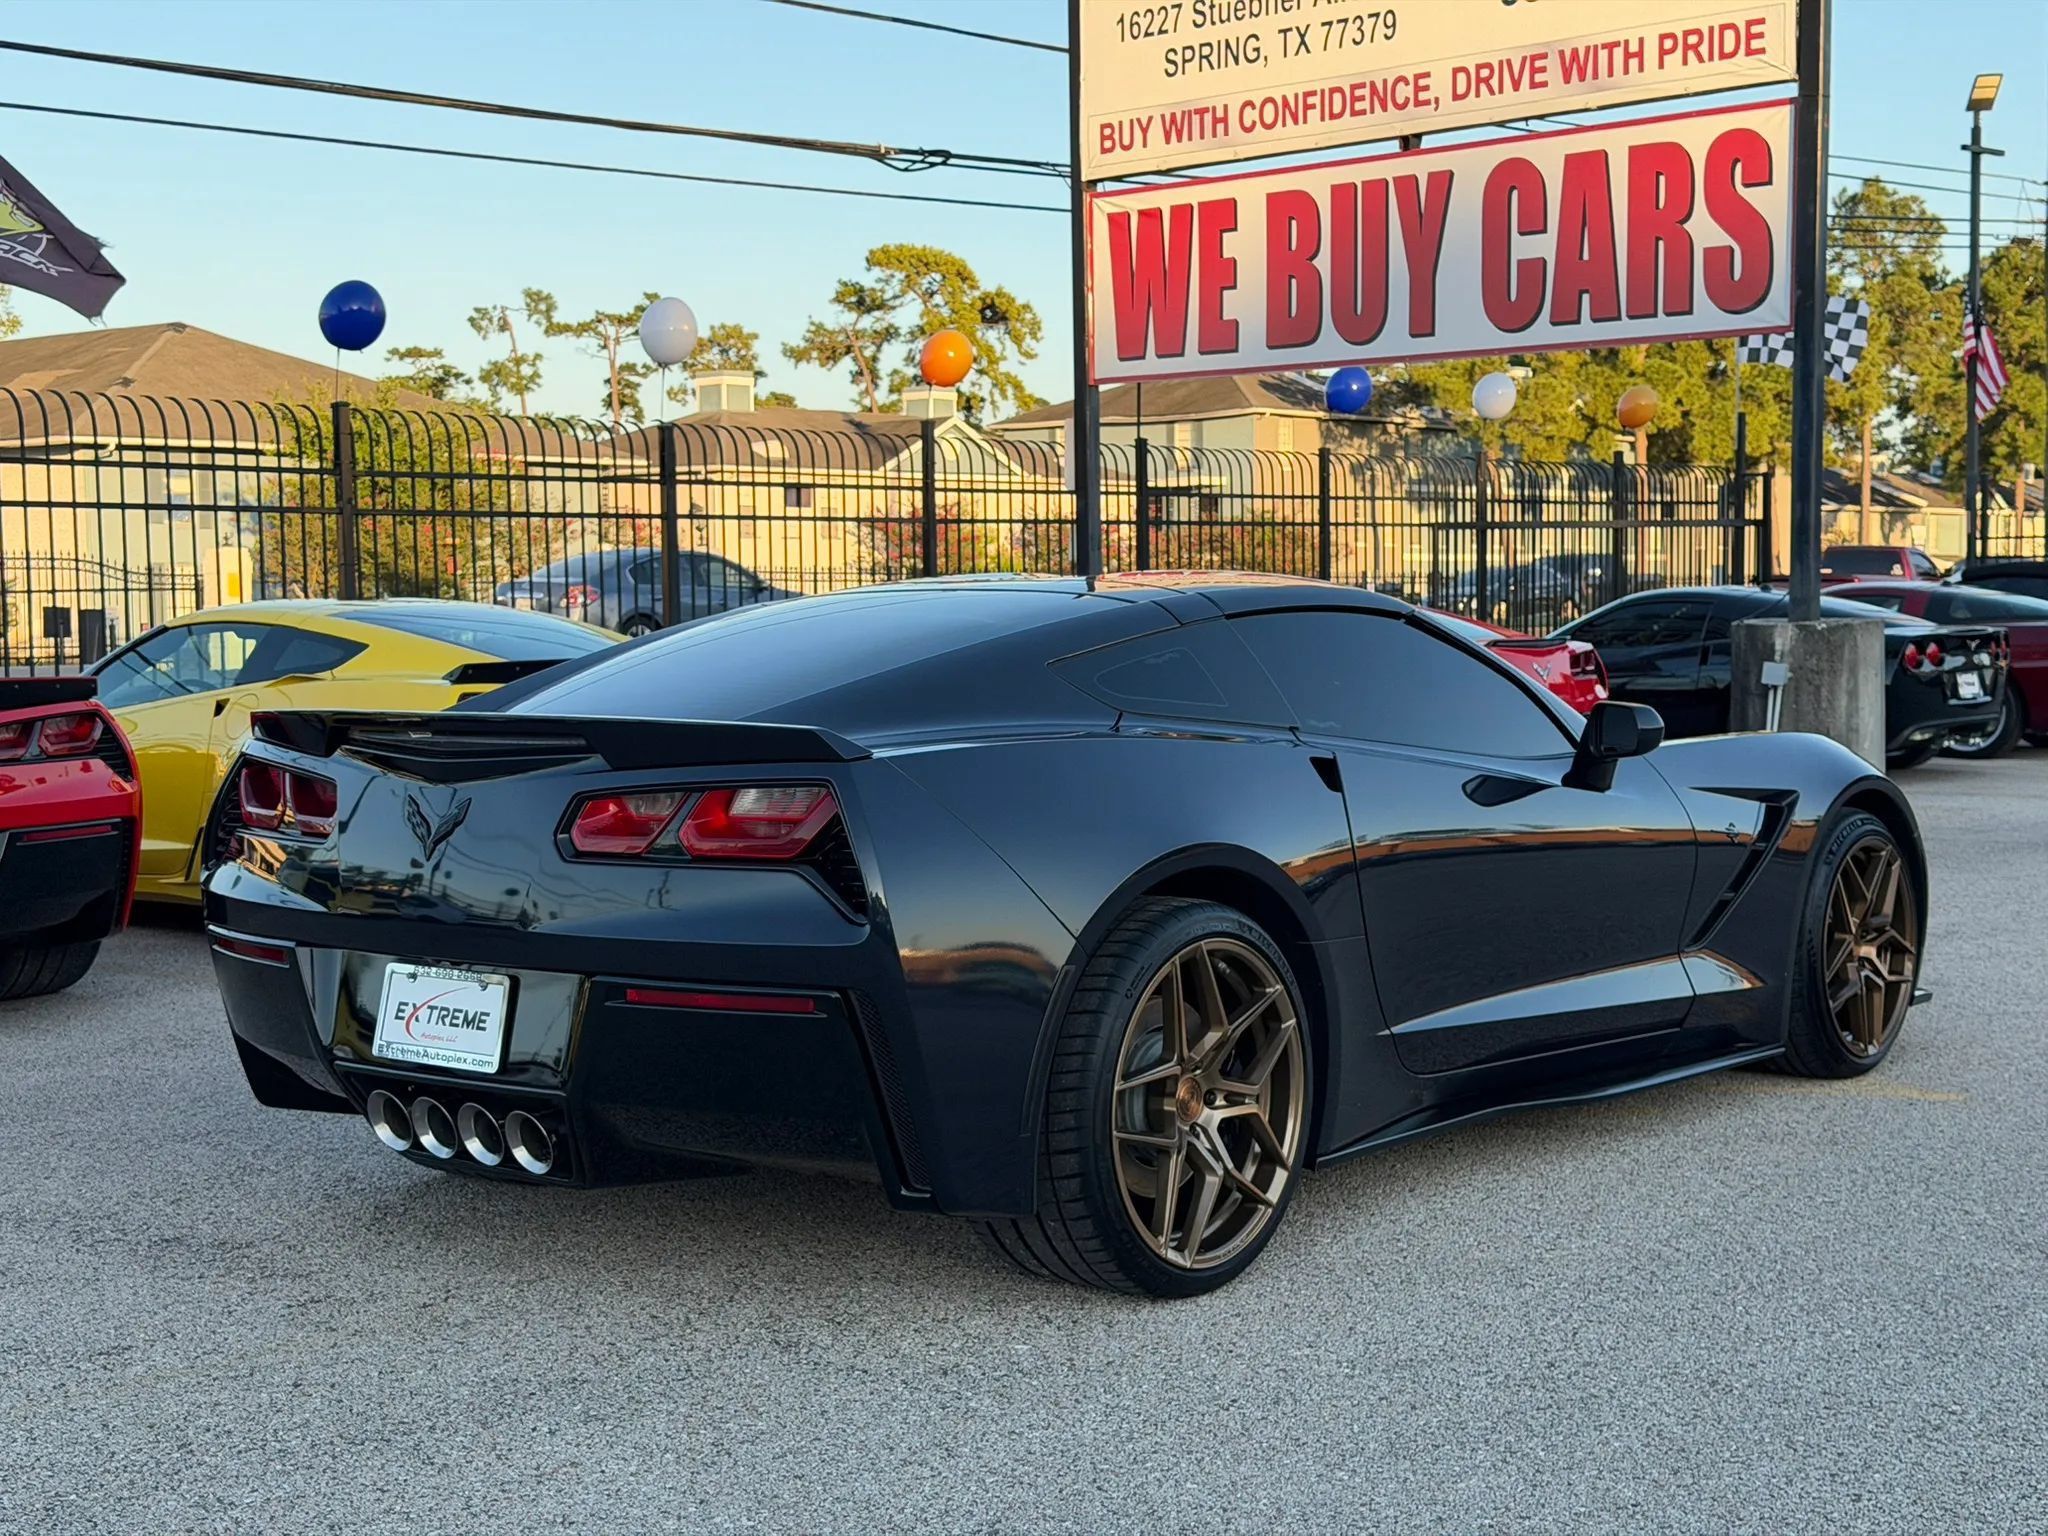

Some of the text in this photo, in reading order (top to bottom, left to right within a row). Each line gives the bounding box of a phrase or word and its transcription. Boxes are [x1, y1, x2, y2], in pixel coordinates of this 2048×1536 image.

[1116, 3, 1183, 42] 16227
[1164, 9, 1397, 77] SPRING, TX 77379
[1100, 17, 1767, 154] BUY WITH CONFIDENCE, DRIVE WITH PRIDE
[1107, 127, 1774, 362] WE BUY CARS
[394, 1001, 491, 1032] EXTREME
